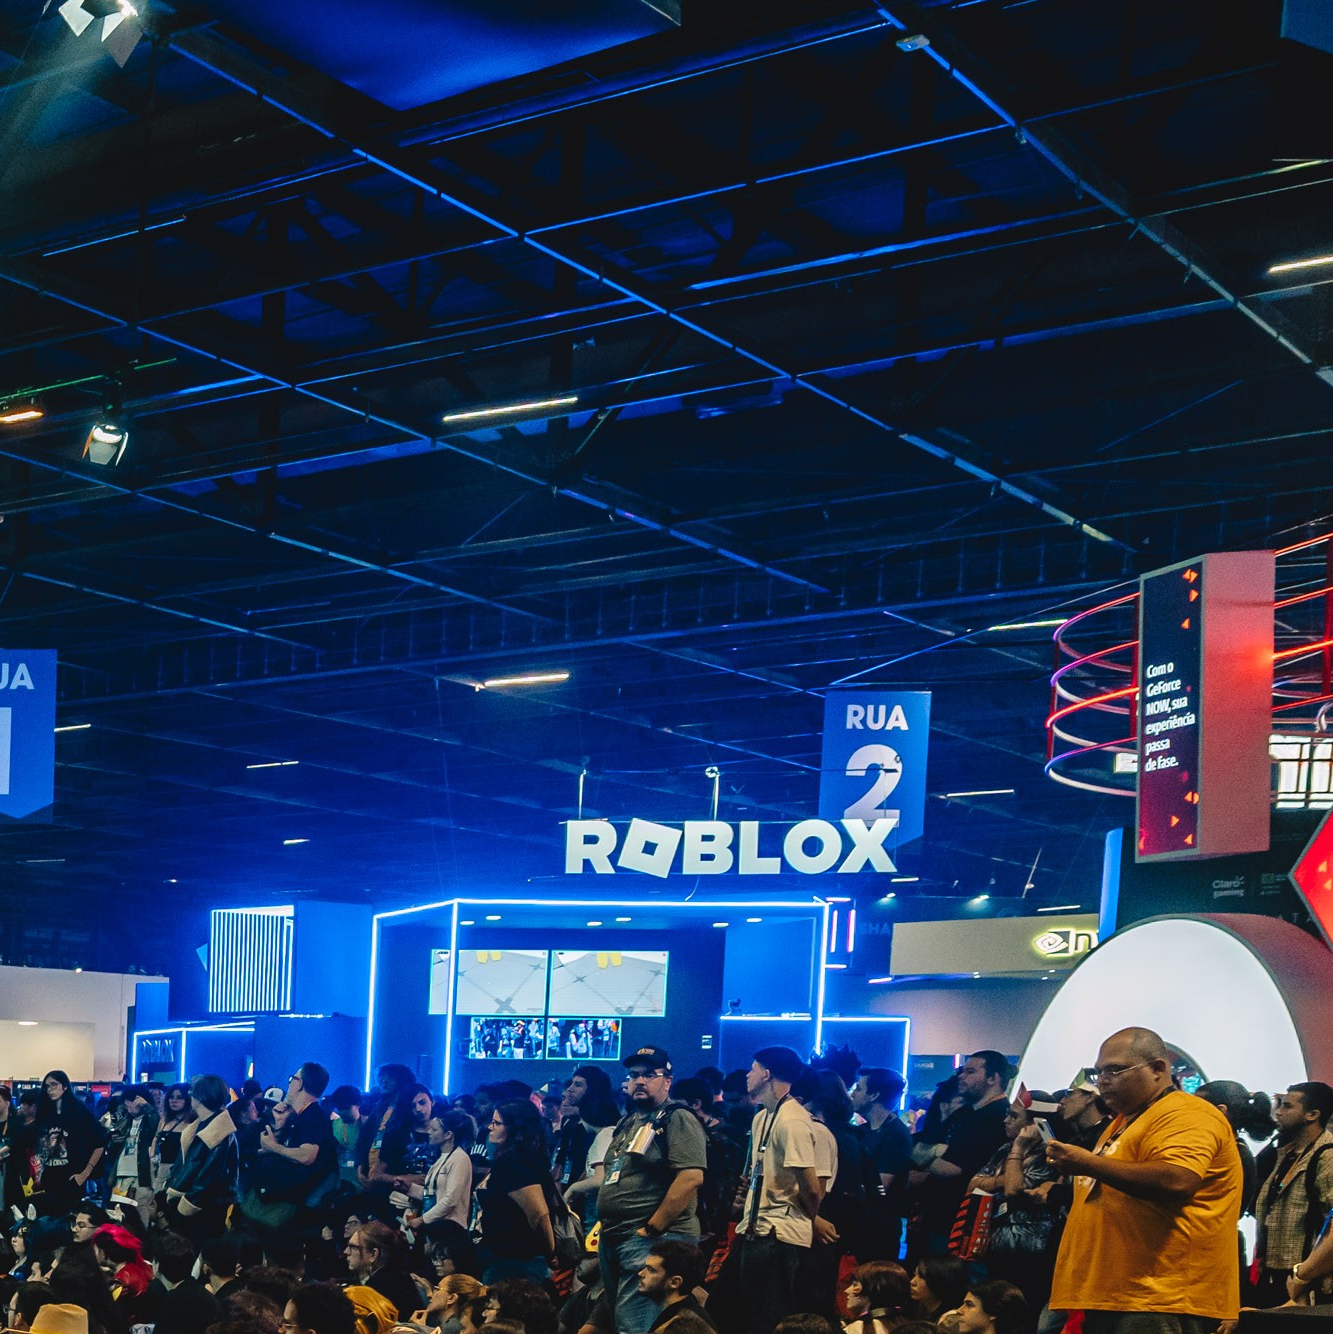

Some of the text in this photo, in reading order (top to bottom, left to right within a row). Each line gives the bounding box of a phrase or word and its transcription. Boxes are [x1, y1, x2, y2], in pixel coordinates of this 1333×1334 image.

[1146, 662, 1175, 679] Com o
[1146, 679, 1182, 698] GeForce
[1145, 696, 1189, 716] NOW, sua
[845, 704, 909, 732] RUA
[1145, 712, 1196, 736] experiência
[1144, 738, 1171, 756] passa
[1144, 757, 1157, 772] de
[843, 743, 904, 827] 2
[565, 817, 899, 879] ROBLOX
